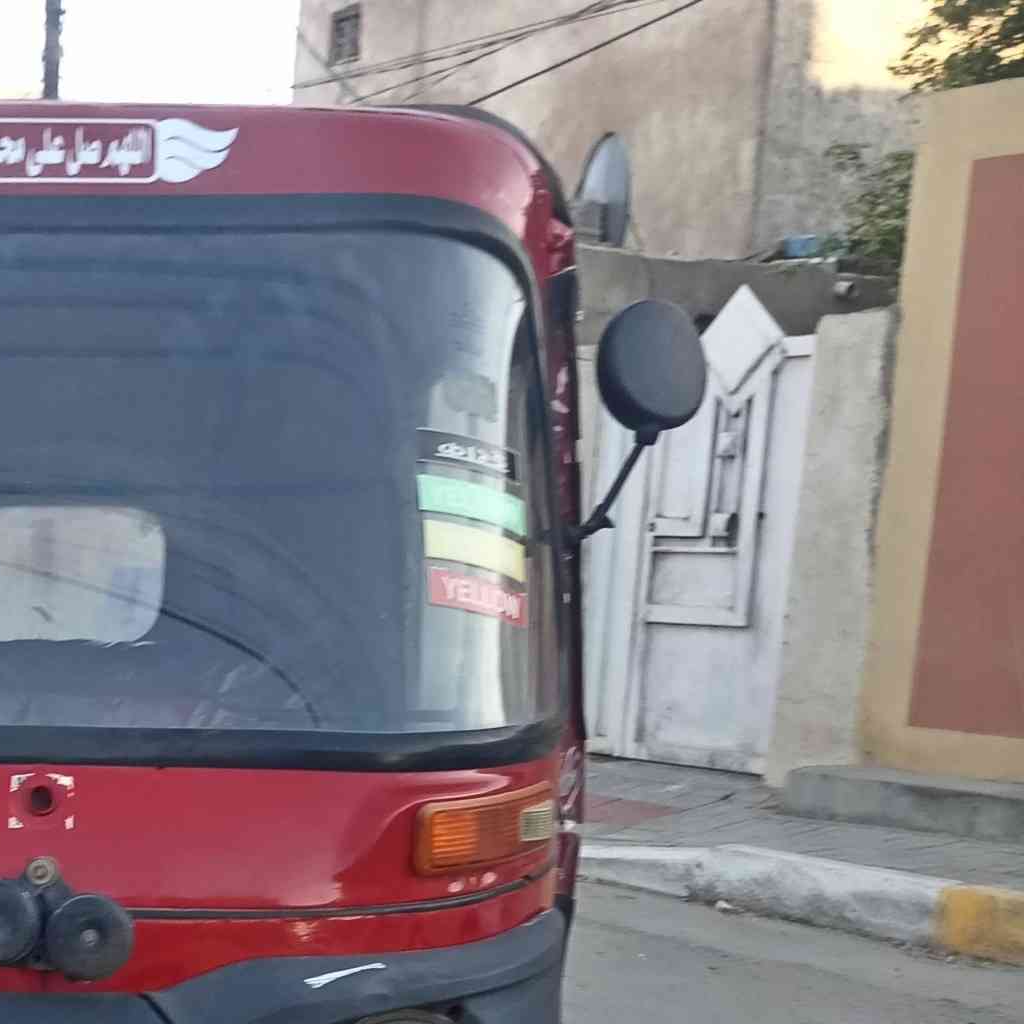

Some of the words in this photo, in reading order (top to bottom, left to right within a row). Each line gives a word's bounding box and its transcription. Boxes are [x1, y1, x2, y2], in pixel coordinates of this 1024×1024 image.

[25, 127, 66, 176] على
[65, 126, 102, 176] صل
[99, 126, 153, 176] اللهم
